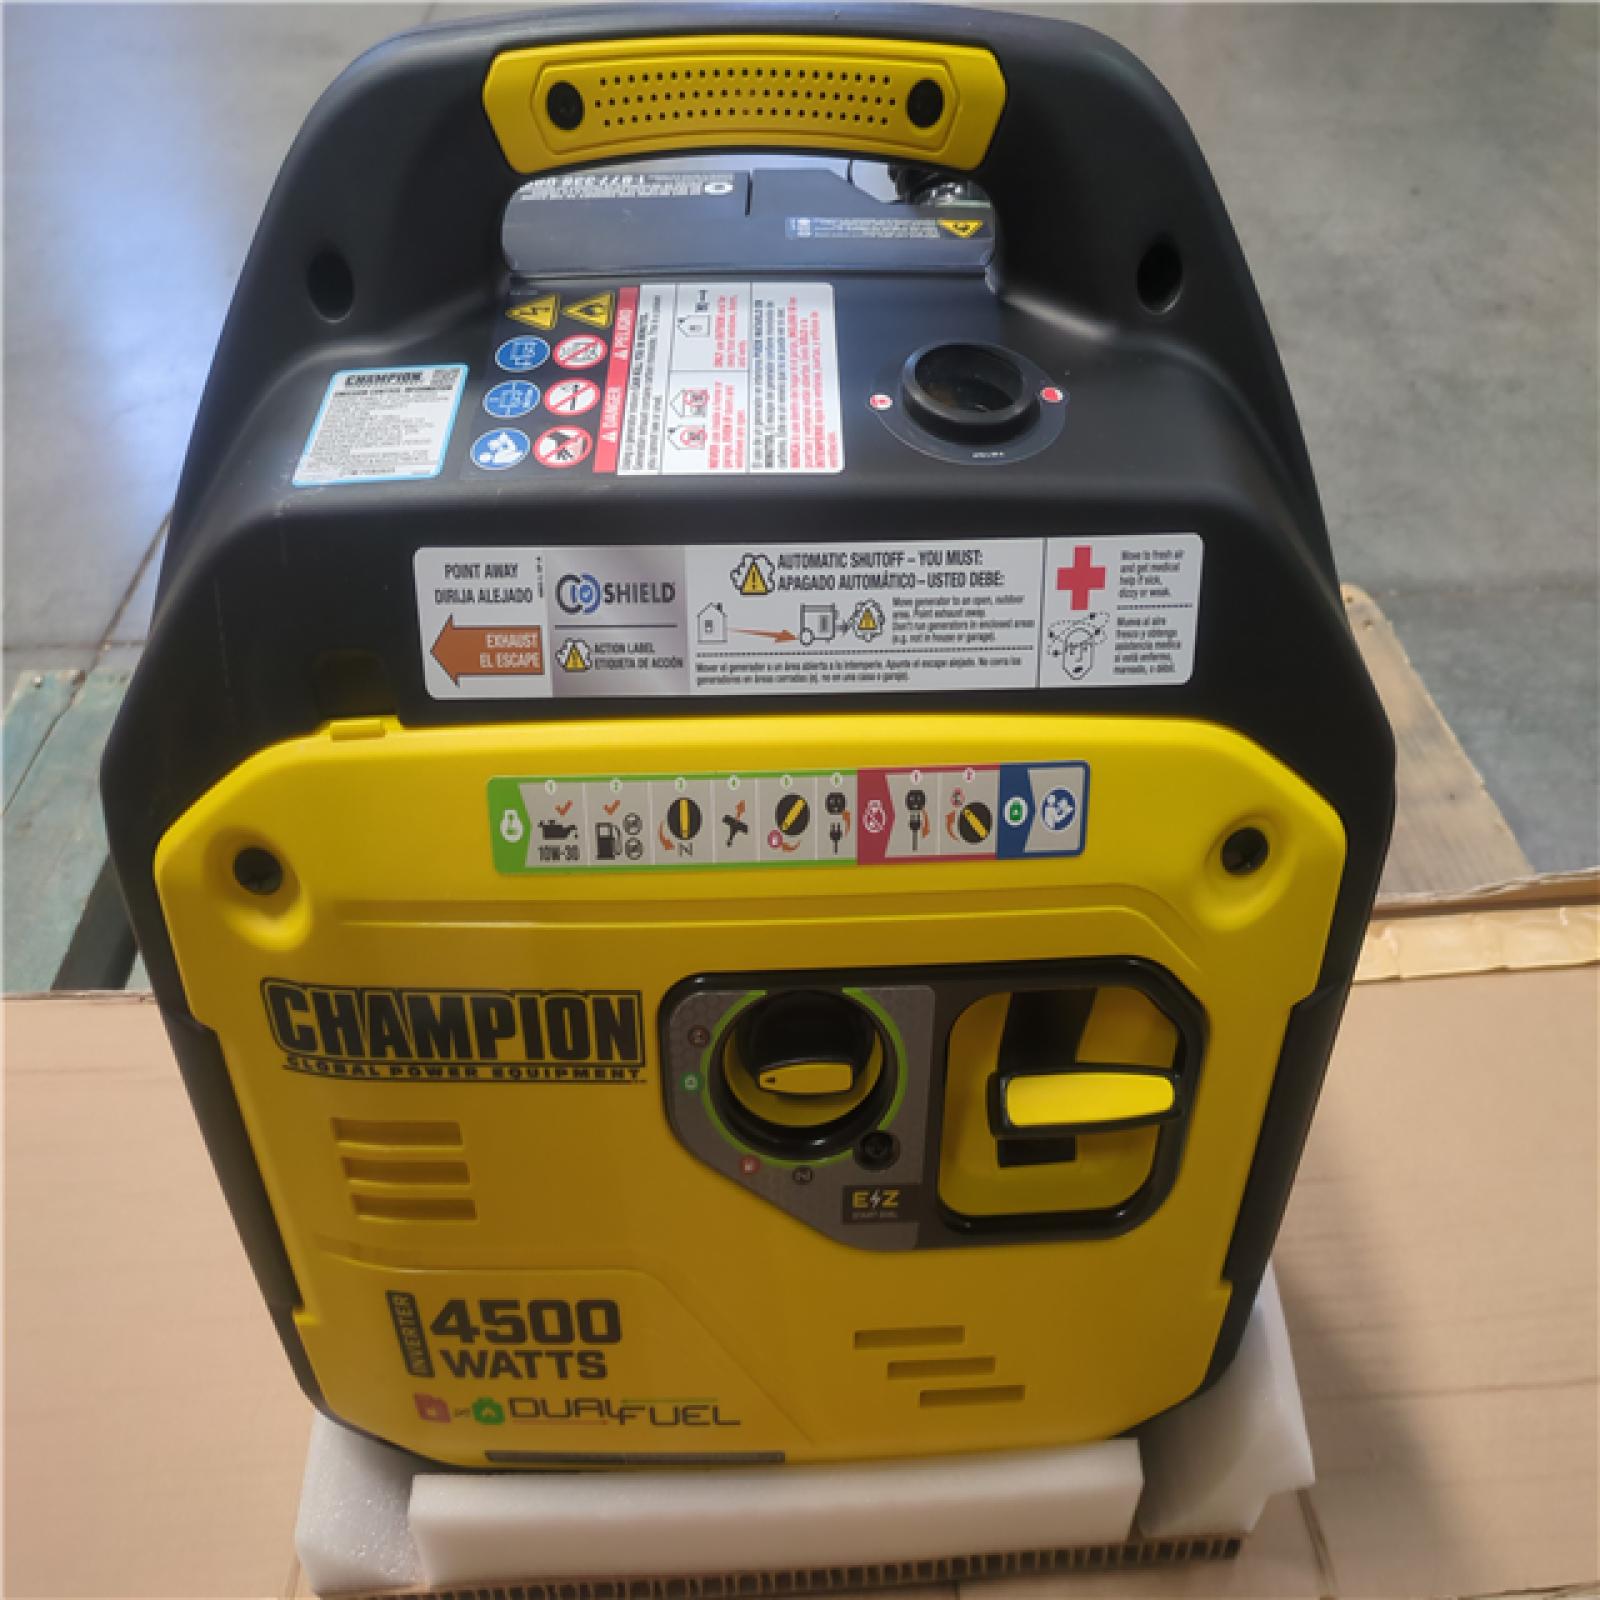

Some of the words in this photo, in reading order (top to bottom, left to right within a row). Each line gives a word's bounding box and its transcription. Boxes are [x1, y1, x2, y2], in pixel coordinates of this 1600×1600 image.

[615, 308, 631, 348] PELIGRO
[344, 372, 423, 386] CHAMPION
[602, 386, 620, 429] DANGER
[777, 553, 848, 569] AUTOMATIC
[850, 551, 905, 567] SHUTOFF
[919, 550, 943, 566] YOU
[945, 549, 984, 565] MUST:
[444, 563, 481, 579] POINT
[484, 563, 518, 579] AWAY
[777, 574, 836, 590] APAGADO
[839, 570, 915, 590] AUTOMÁTICO
[927, 572, 965, 588] USTED
[969, 570, 1005, 587] DEBE:
[434, 588, 475, 604] DIRIJA
[478, 587, 534, 604] ALEJADO
[603, 582, 676, 603] SHIELD
[485, 633, 538, 649] EXHAUST
[594, 642, 625, 654] ACTION
[627, 642, 656, 654] LABEL
[479, 654, 494, 668] EL
[496, 654, 541, 669] ESCAPE
[594, 657, 635, 670] ETIQUETA
[636, 657, 650, 669] DE
[651, 655, 684, 669] ACCIÓN
[538, 844, 580, 861] 10W-30
[678, 842, 693, 857] N
[265, 984, 642, 1063] CHAMPION
[286, 1054, 381, 1078] GLOBAL
[389, 1065, 479, 1080] POWER
[492, 1066, 640, 1081] EQUIPMENT
[430, 1299, 622, 1345] 4500
[390, 1294, 431, 1375] INVERTER
[439, 1349, 608, 1380] WATTS
